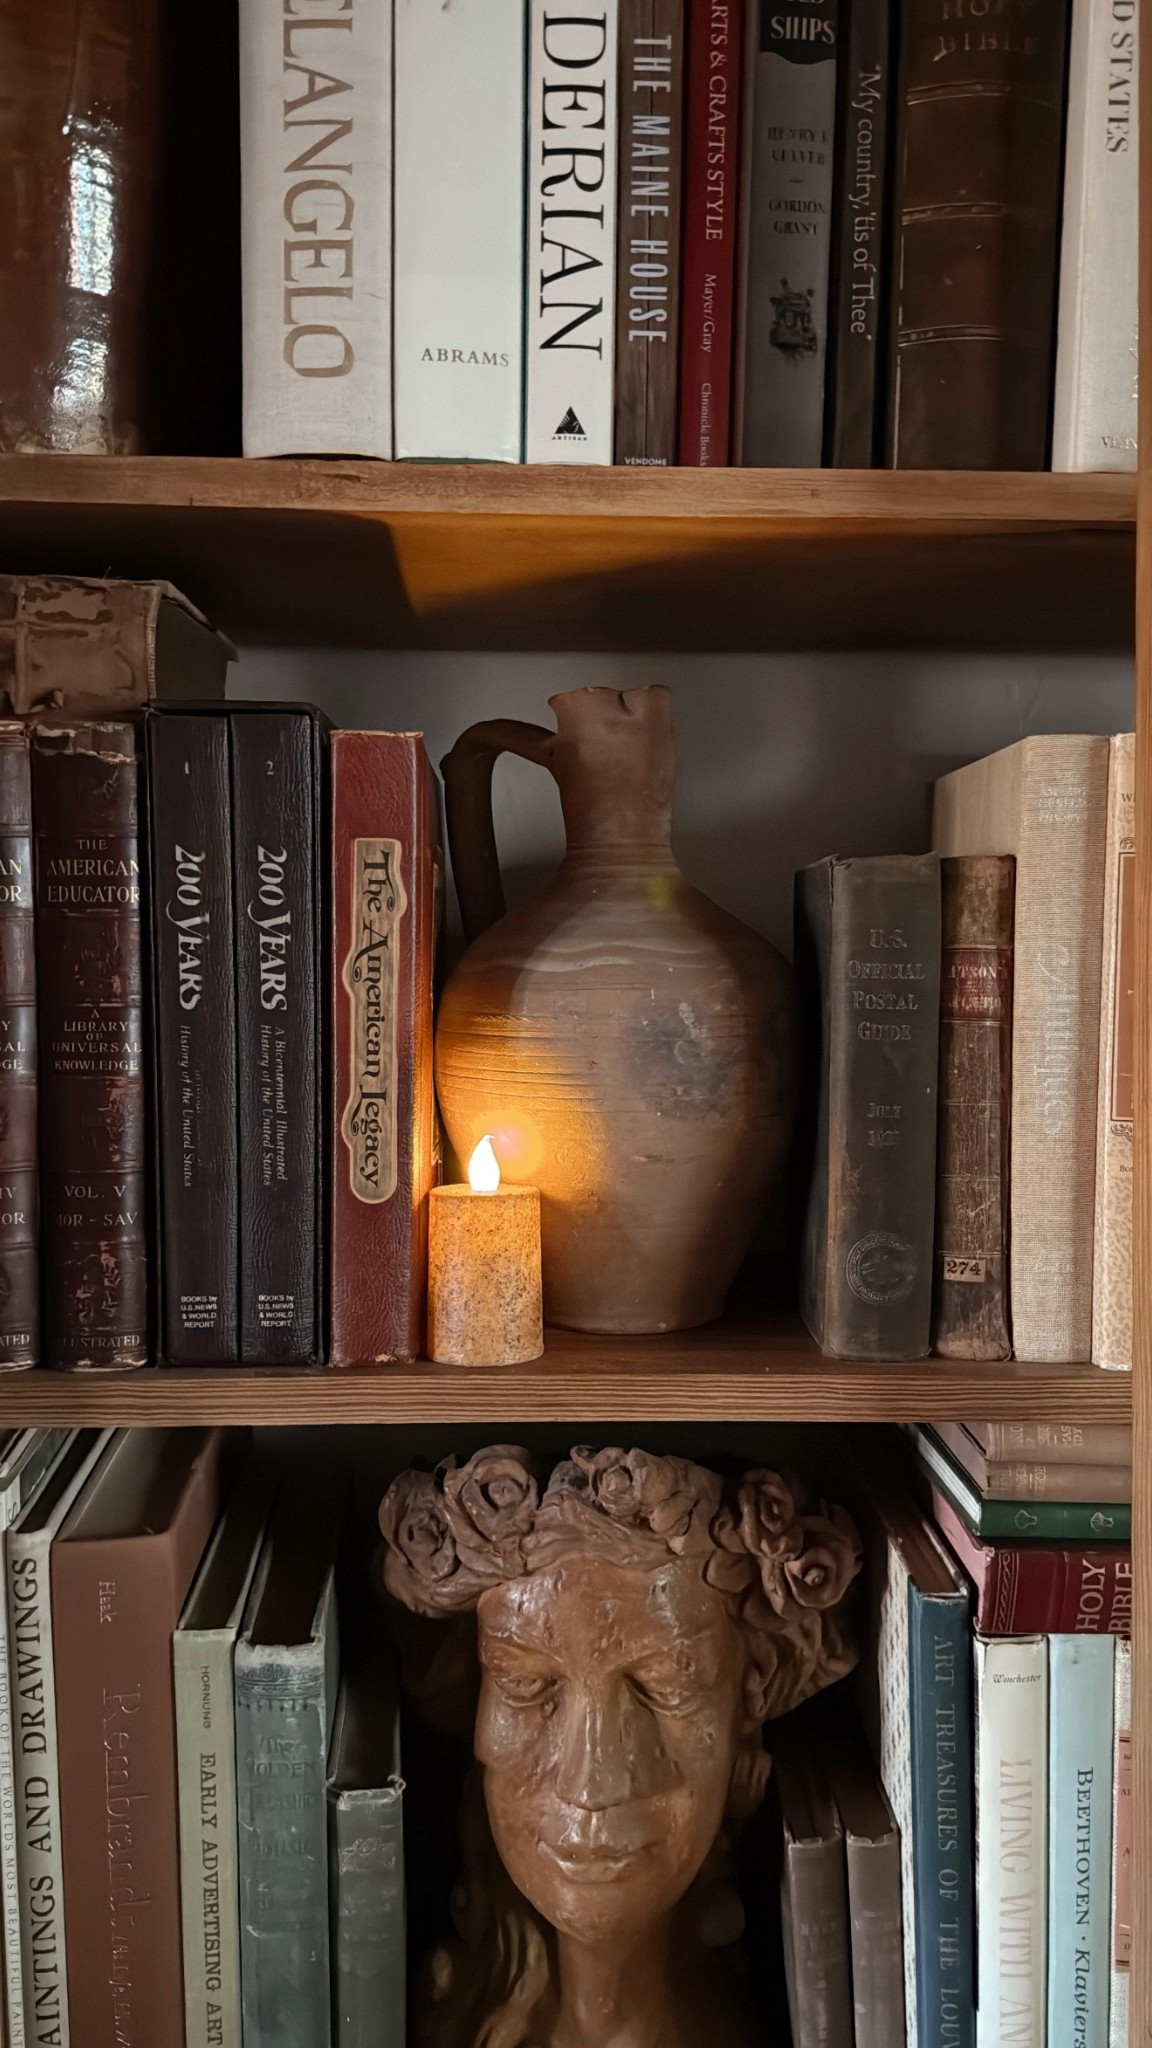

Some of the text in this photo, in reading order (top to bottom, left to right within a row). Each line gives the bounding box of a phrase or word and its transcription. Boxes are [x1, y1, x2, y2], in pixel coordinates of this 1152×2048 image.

[770, 16, 835, 44] SHIPS
[1105, 32, 1134, 154] STATES
[705, 0, 728, 240] RTS & CRAFTS STYLE
[540, 11, 607, 360] DERIAN
[627, 35, 673, 342] THE MAINE HOUSE
[853, 248, 876, 272] of
[421, 347, 509, 367] ABRAMS
[625, 457, 667, 466] VENDOME
[266, 761, 275, 775] 2
[76, 839, 108, 851] THE
[47, 859, 140, 877] AMERICAN
[175, 844, 206, 906] 200
[258, 845, 288, 906] 200
[47, 885, 140, 903] EDUCATOR
[869, 929, 908, 949] U.S.
[848, 960, 926, 980] OFFICIAL
[349, 849, 397, 1189] The American Legacy
[852, 990, 918, 1011] POSTAL
[52, 1042, 143, 1053] UNIVERSAL
[64, 1021, 129, 1032] LIBRARY
[86, 1033, 103, 1041] OF
[178, 1024, 192, 1069] History
[857, 1021, 912, 1041] GUIDE
[54, 1059, 139, 1071] KNOWLEDGE
[274, 1040, 288, 1114] Bicentennial
[181, 1087, 194, 1106] the
[258, 1024, 274, 1187] History of the United States
[182, 1109, 194, 1148] United
[275, 1120, 288, 1181] Illustrated
[64, 1185, 126, 1198] VOL. V
[183, 1152, 194, 1188] States
[103, 1211, 138, 1227] SAV
[946, 1261, 982, 1277] 274
[1075, 1558, 1106, 1631] HOLY
[1107, 1563, 1132, 1633] BIBLE
[12, 1558, 47, 1754] DRAWINGS
[934, 1635, 955, 1688] ART
[993, 1672, 1042, 1684] Winchester
[201, 1665, 212, 1729] HORNUNG
[1, 1750, 12, 1778] THE
[936, 1703, 958, 1852] TREASURES
[25, 1775, 52, 1853] AND
[103, 1682, 152, 1925] Rembrandt
[1000, 1759, 1032, 1874] LIVING
[1075, 1766, 1094, 1926] BEETHOVEN
[5, 1858, 17, 1902] MOST
[200, 1753, 223, 2047] EARLY ADVERTISING ART
[938, 1868, 959, 1903] OF
[7, 1908, 21, 1994] BEAUTIFUL
[939, 1916, 961, 1971] THE
[1000, 1889, 1032, 1980] WITH
